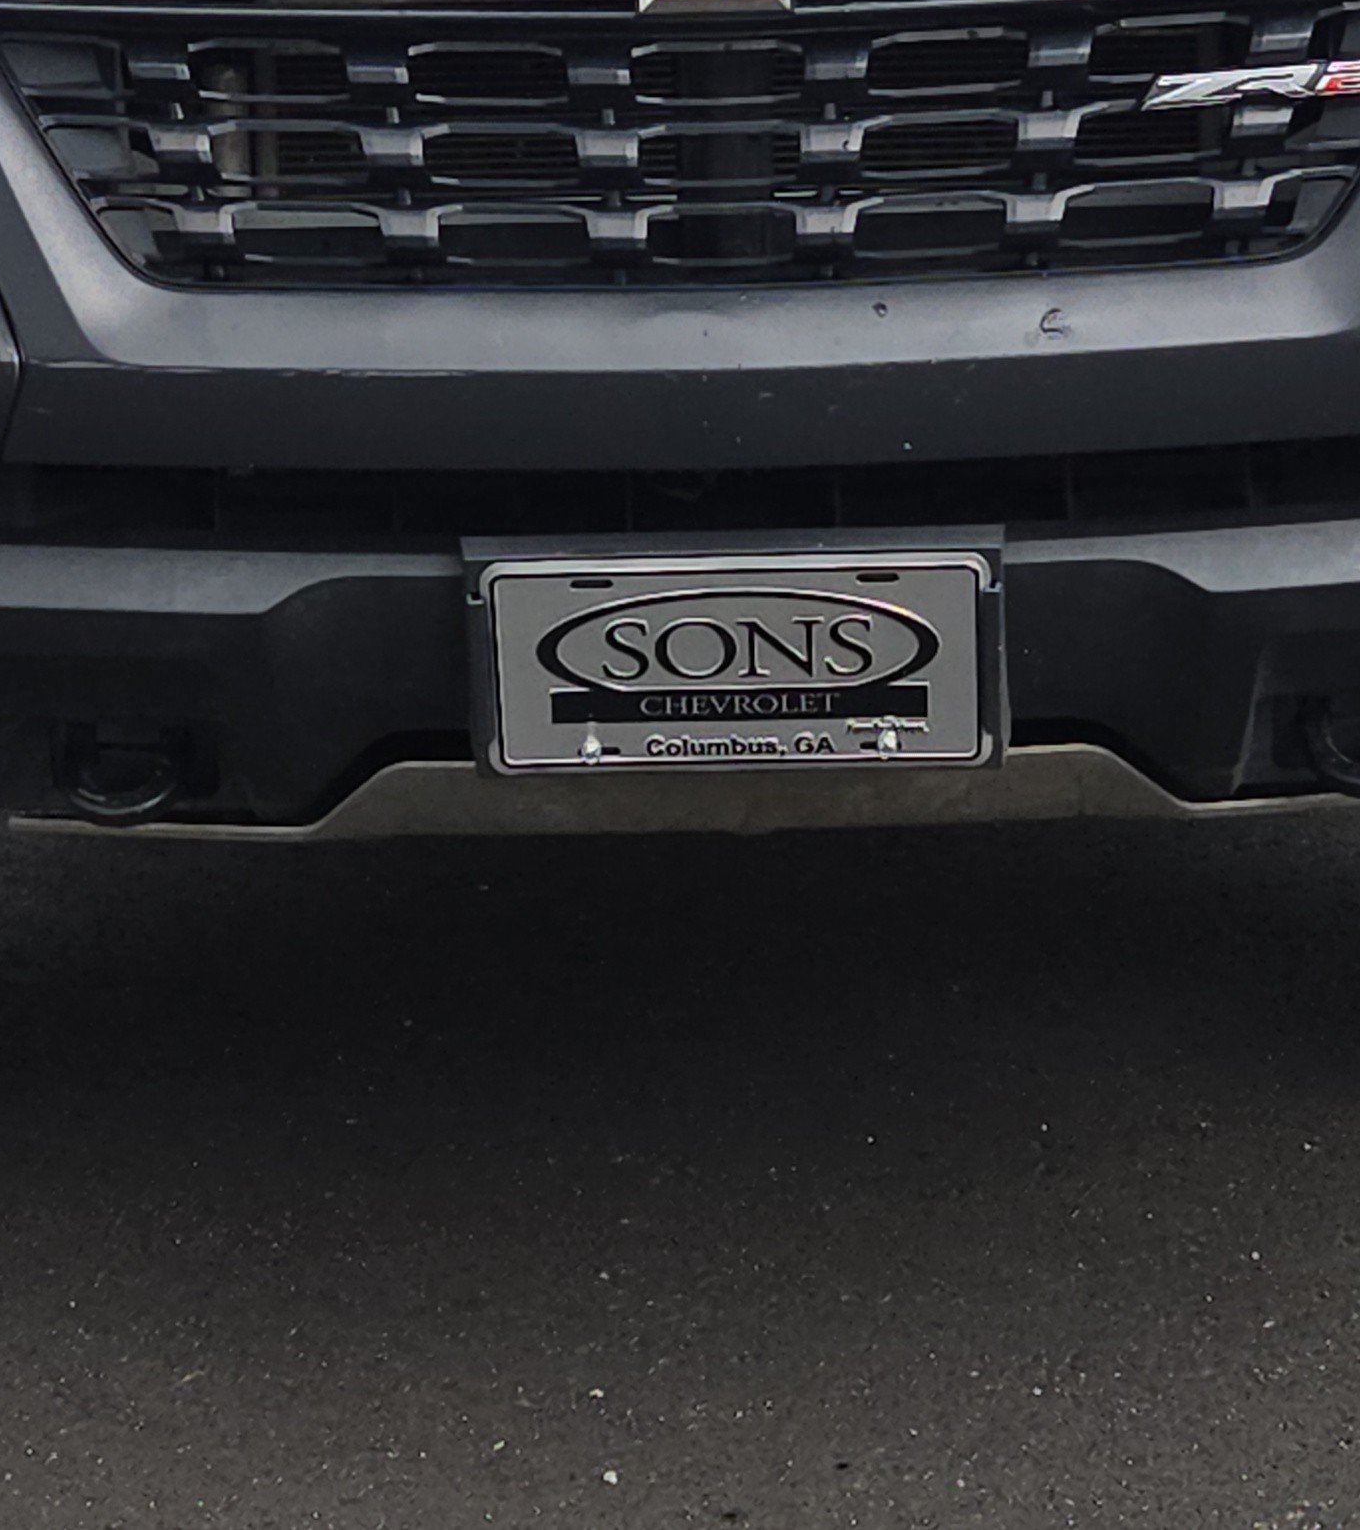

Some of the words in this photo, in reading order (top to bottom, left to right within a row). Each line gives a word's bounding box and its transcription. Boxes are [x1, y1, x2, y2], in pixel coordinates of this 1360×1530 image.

[601, 614, 874, 680] SONS
[640, 692, 840, 716] CHEVROLET
[645, 733, 787, 757] Columbus,
[794, 731, 836, 755] GA
